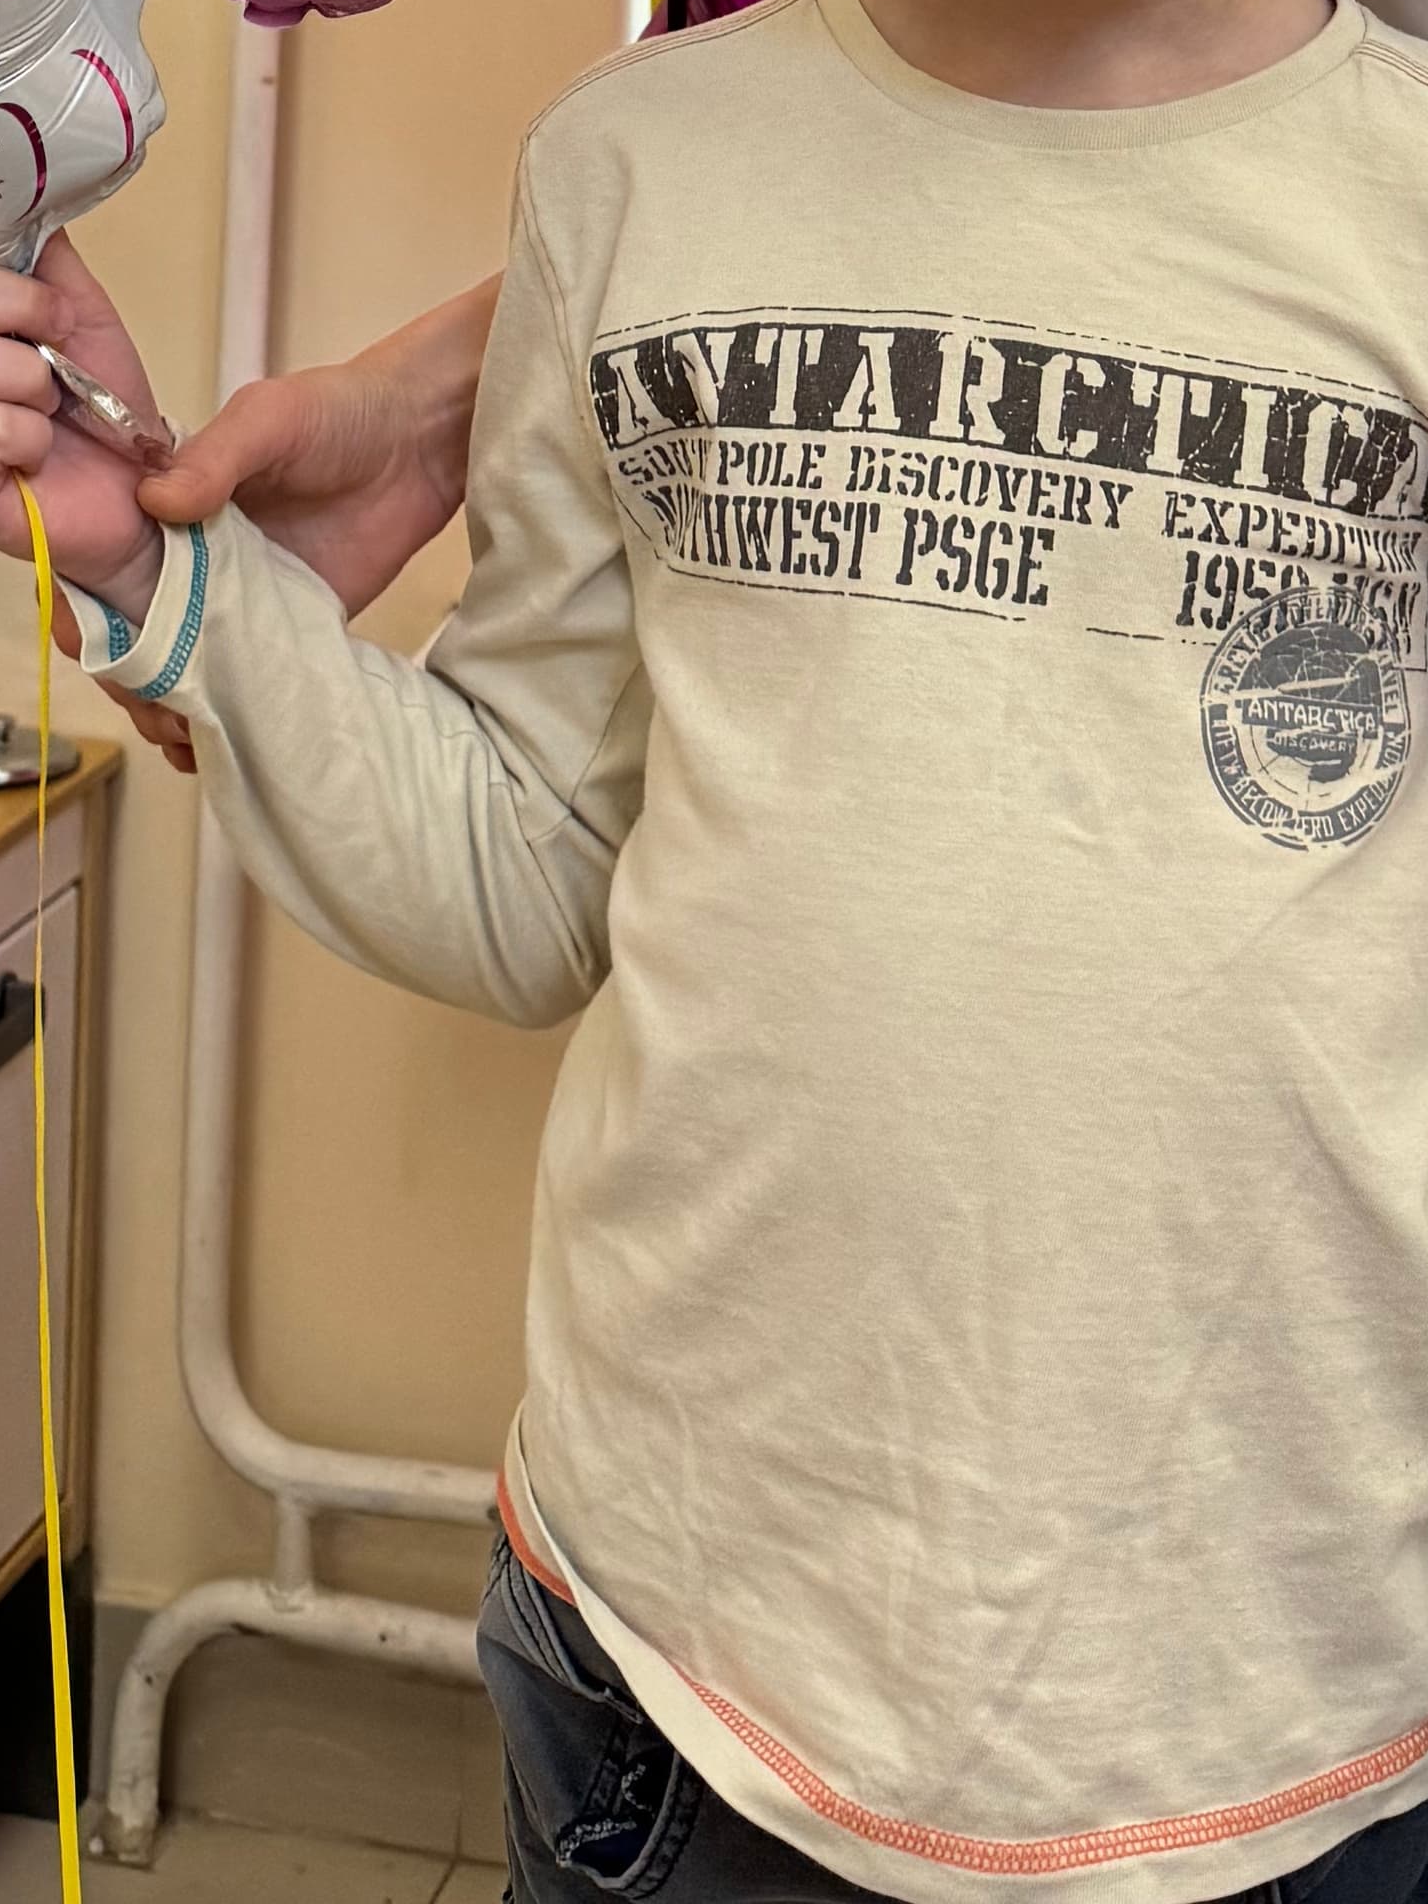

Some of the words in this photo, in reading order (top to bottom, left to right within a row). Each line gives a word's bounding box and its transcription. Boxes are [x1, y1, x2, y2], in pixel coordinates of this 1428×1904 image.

[717, 440, 827, 491] POLE
[845, 444, 1134, 530] DISCOVERY
[1161, 490, 1423, 575] EXPEDITION
[895, 507, 1056, 606] PSGE
[1337, 731, 1404, 832] EXPEDION
